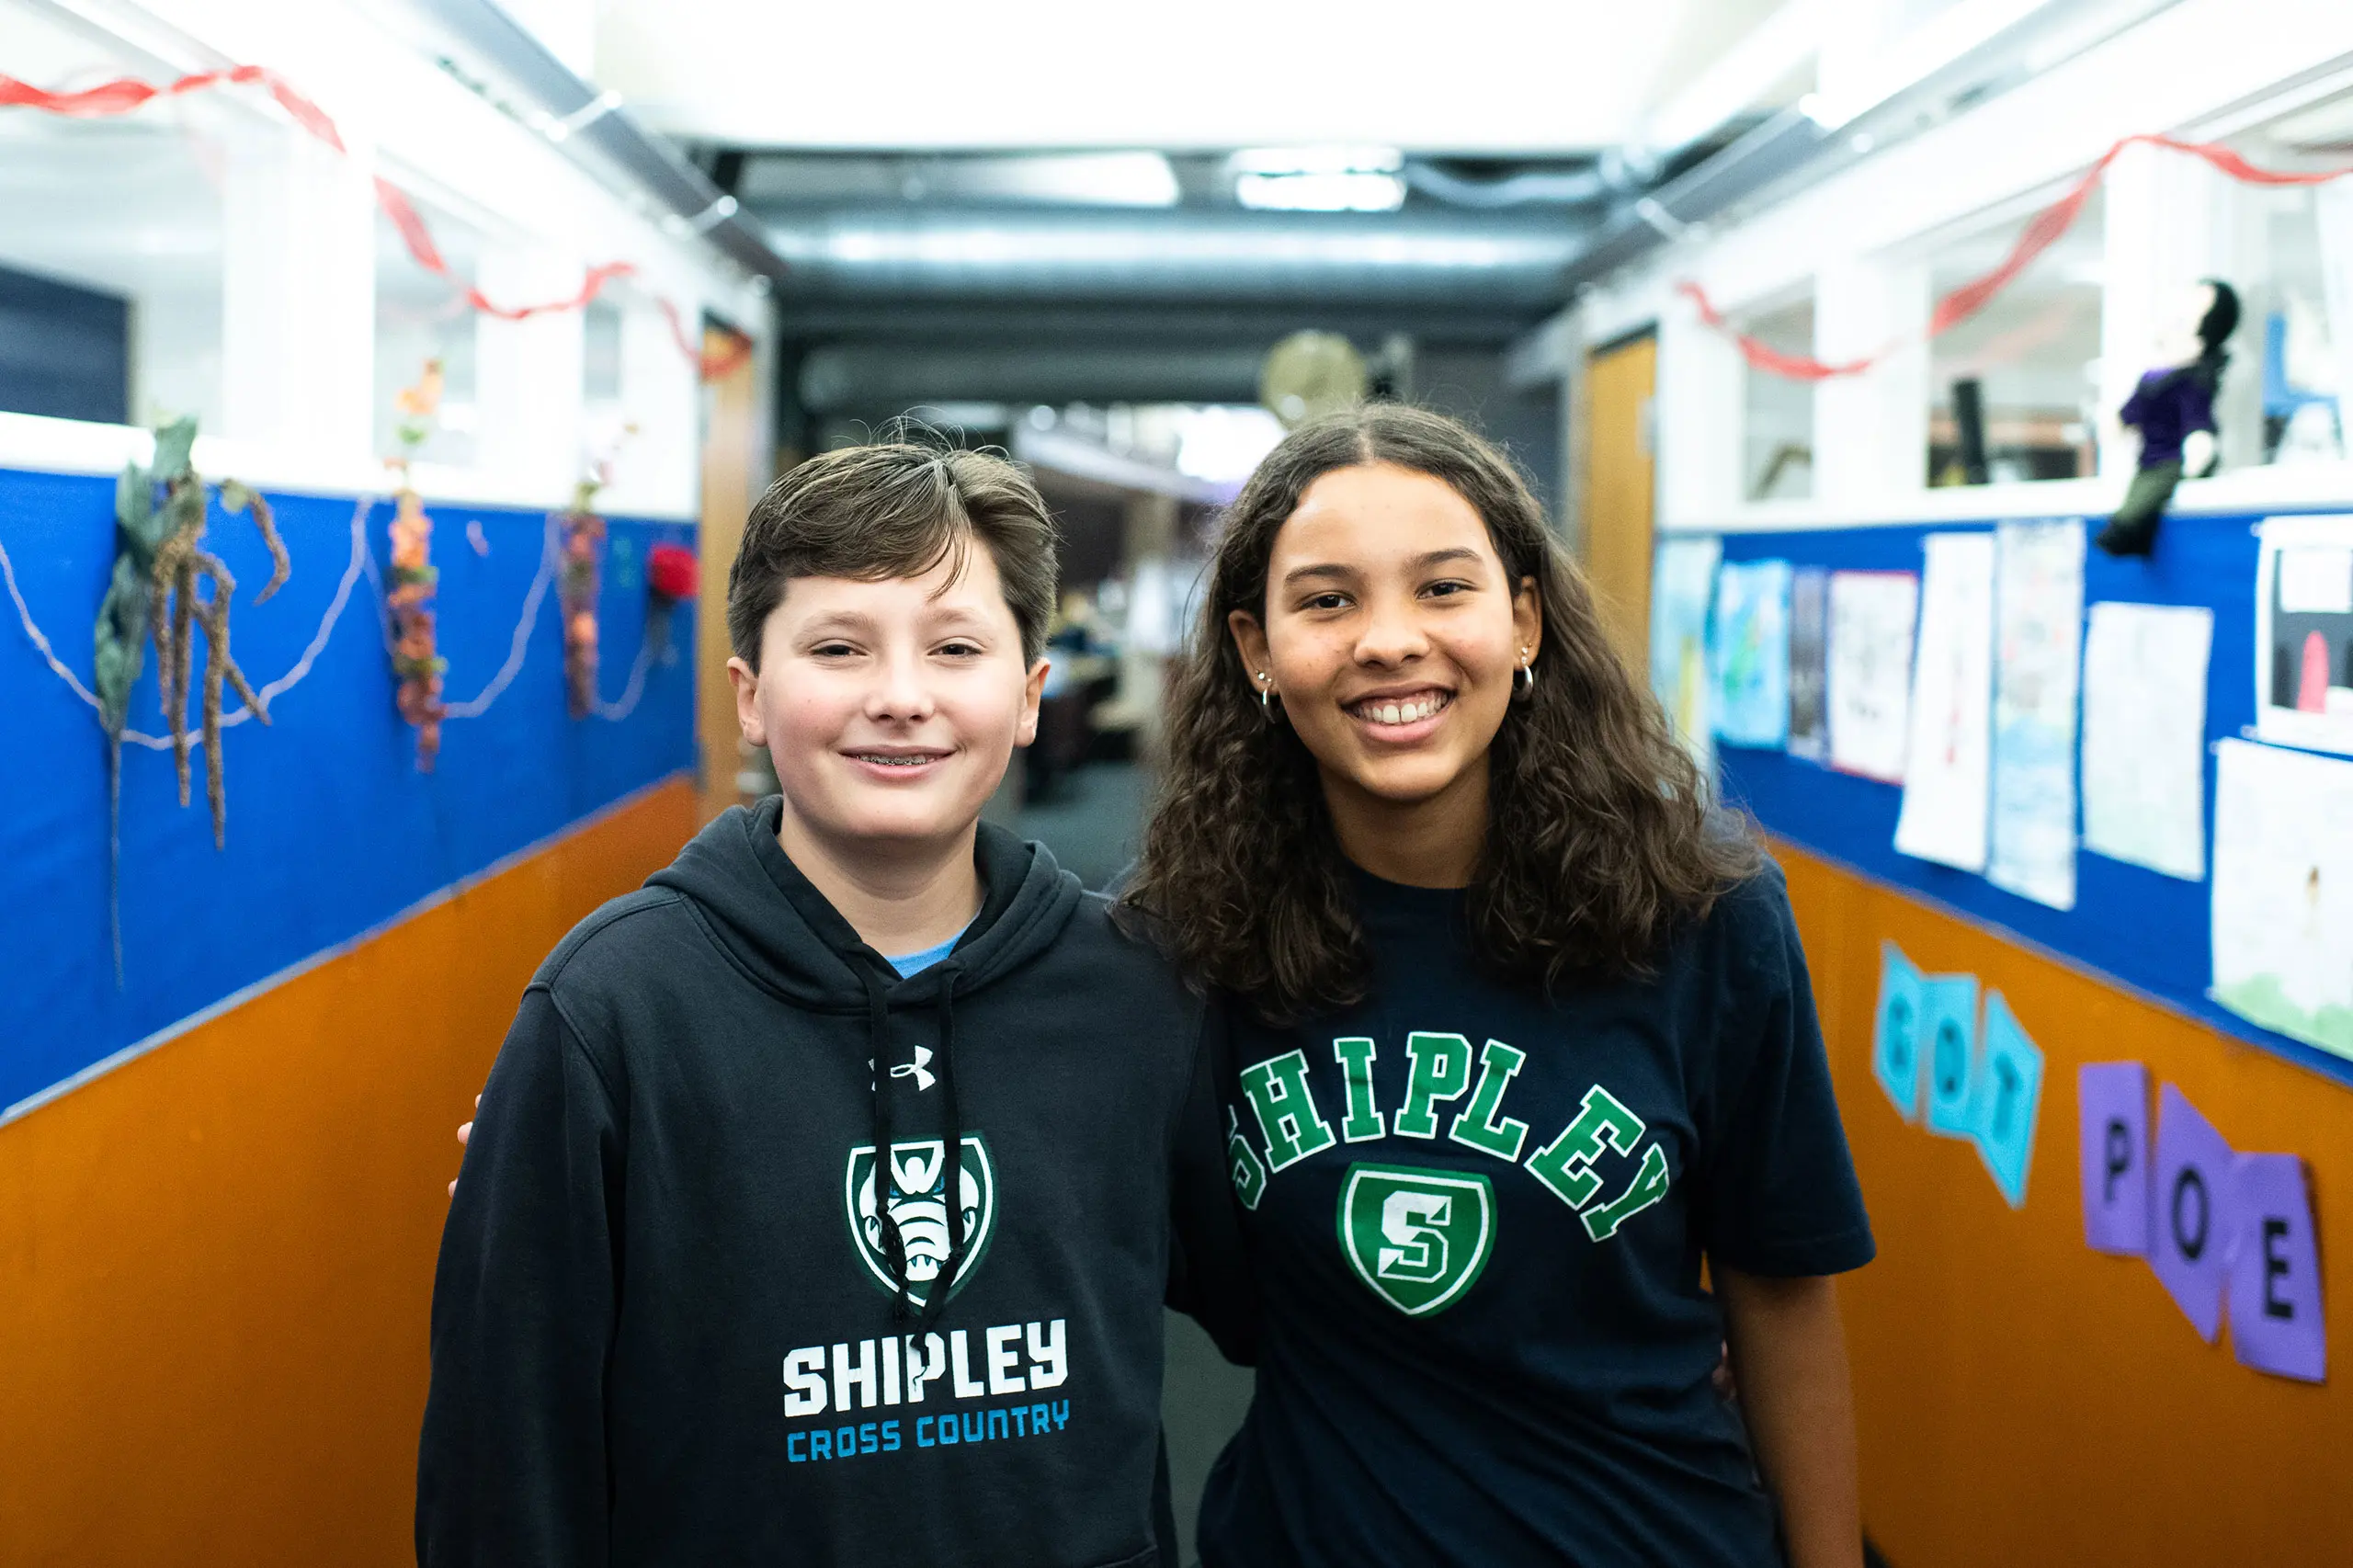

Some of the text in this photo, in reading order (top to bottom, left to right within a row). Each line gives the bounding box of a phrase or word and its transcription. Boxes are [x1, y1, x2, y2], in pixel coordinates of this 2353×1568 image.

[1377, 1190, 1451, 1283] S
[2104, 1119, 2293, 1321] POE
[782, 1318, 1069, 1418] SHIPLEY
[787, 1399, 1071, 1463] CROSS COUNTRY
